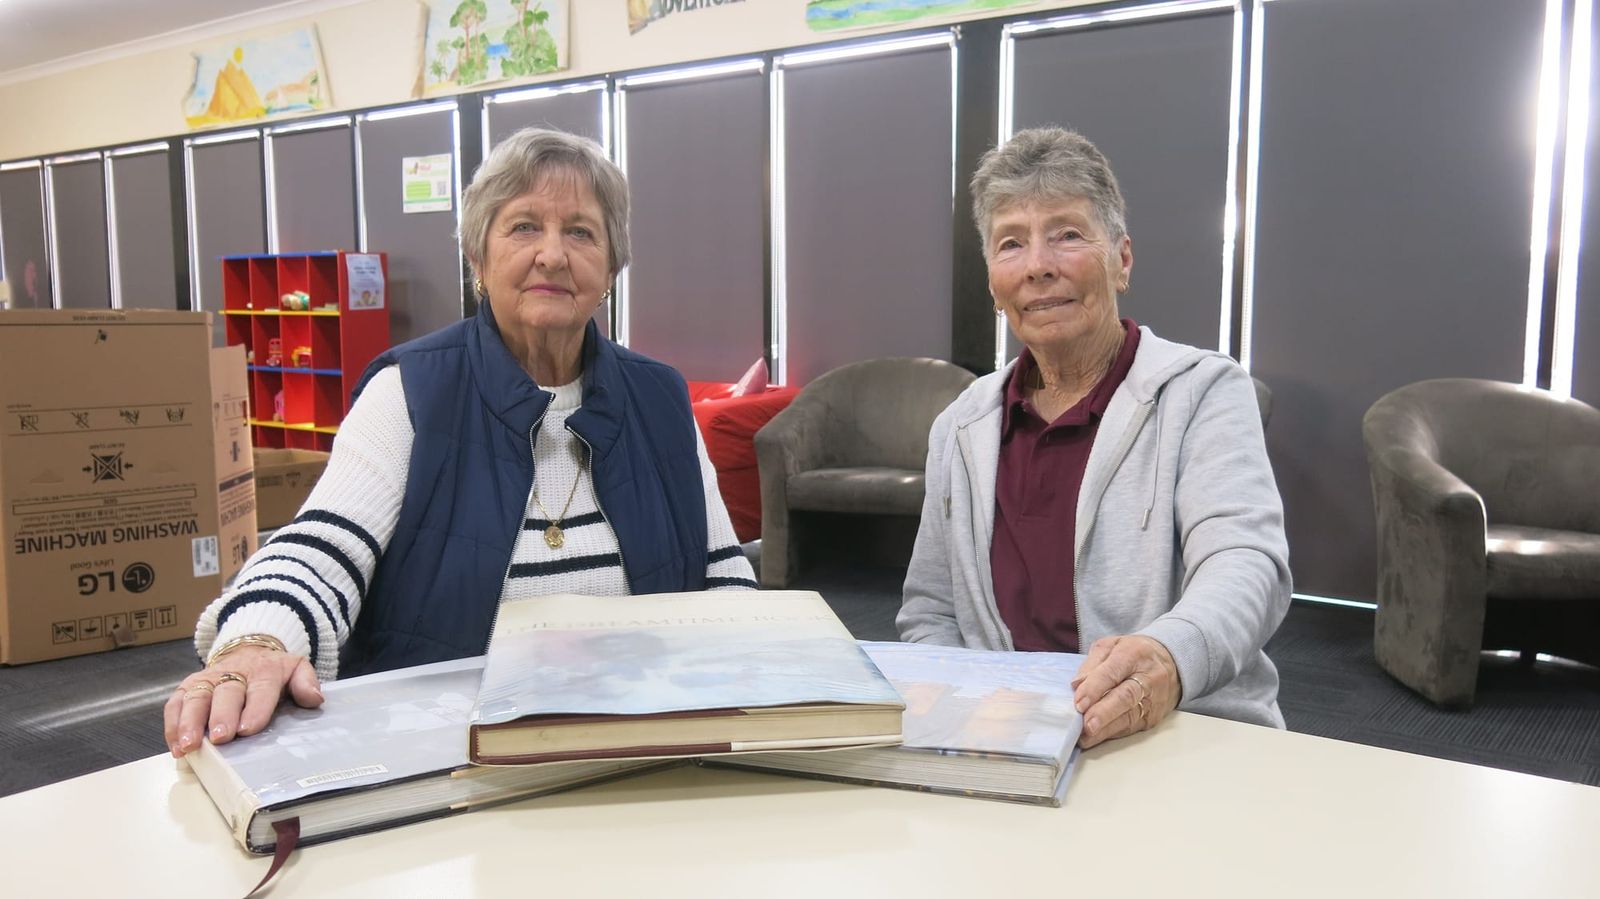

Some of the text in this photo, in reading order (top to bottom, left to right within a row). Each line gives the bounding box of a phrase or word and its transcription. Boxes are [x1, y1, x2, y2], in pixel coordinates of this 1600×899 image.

[15, 530, 106, 554] MACHINE
[113, 519, 198, 543] WASHING
[70, 561, 91, 571] Good
[78, 570, 116, 595] LG
[566, 616, 743, 629] DREAMTIME
[753, 614, 834, 623] BOOK
